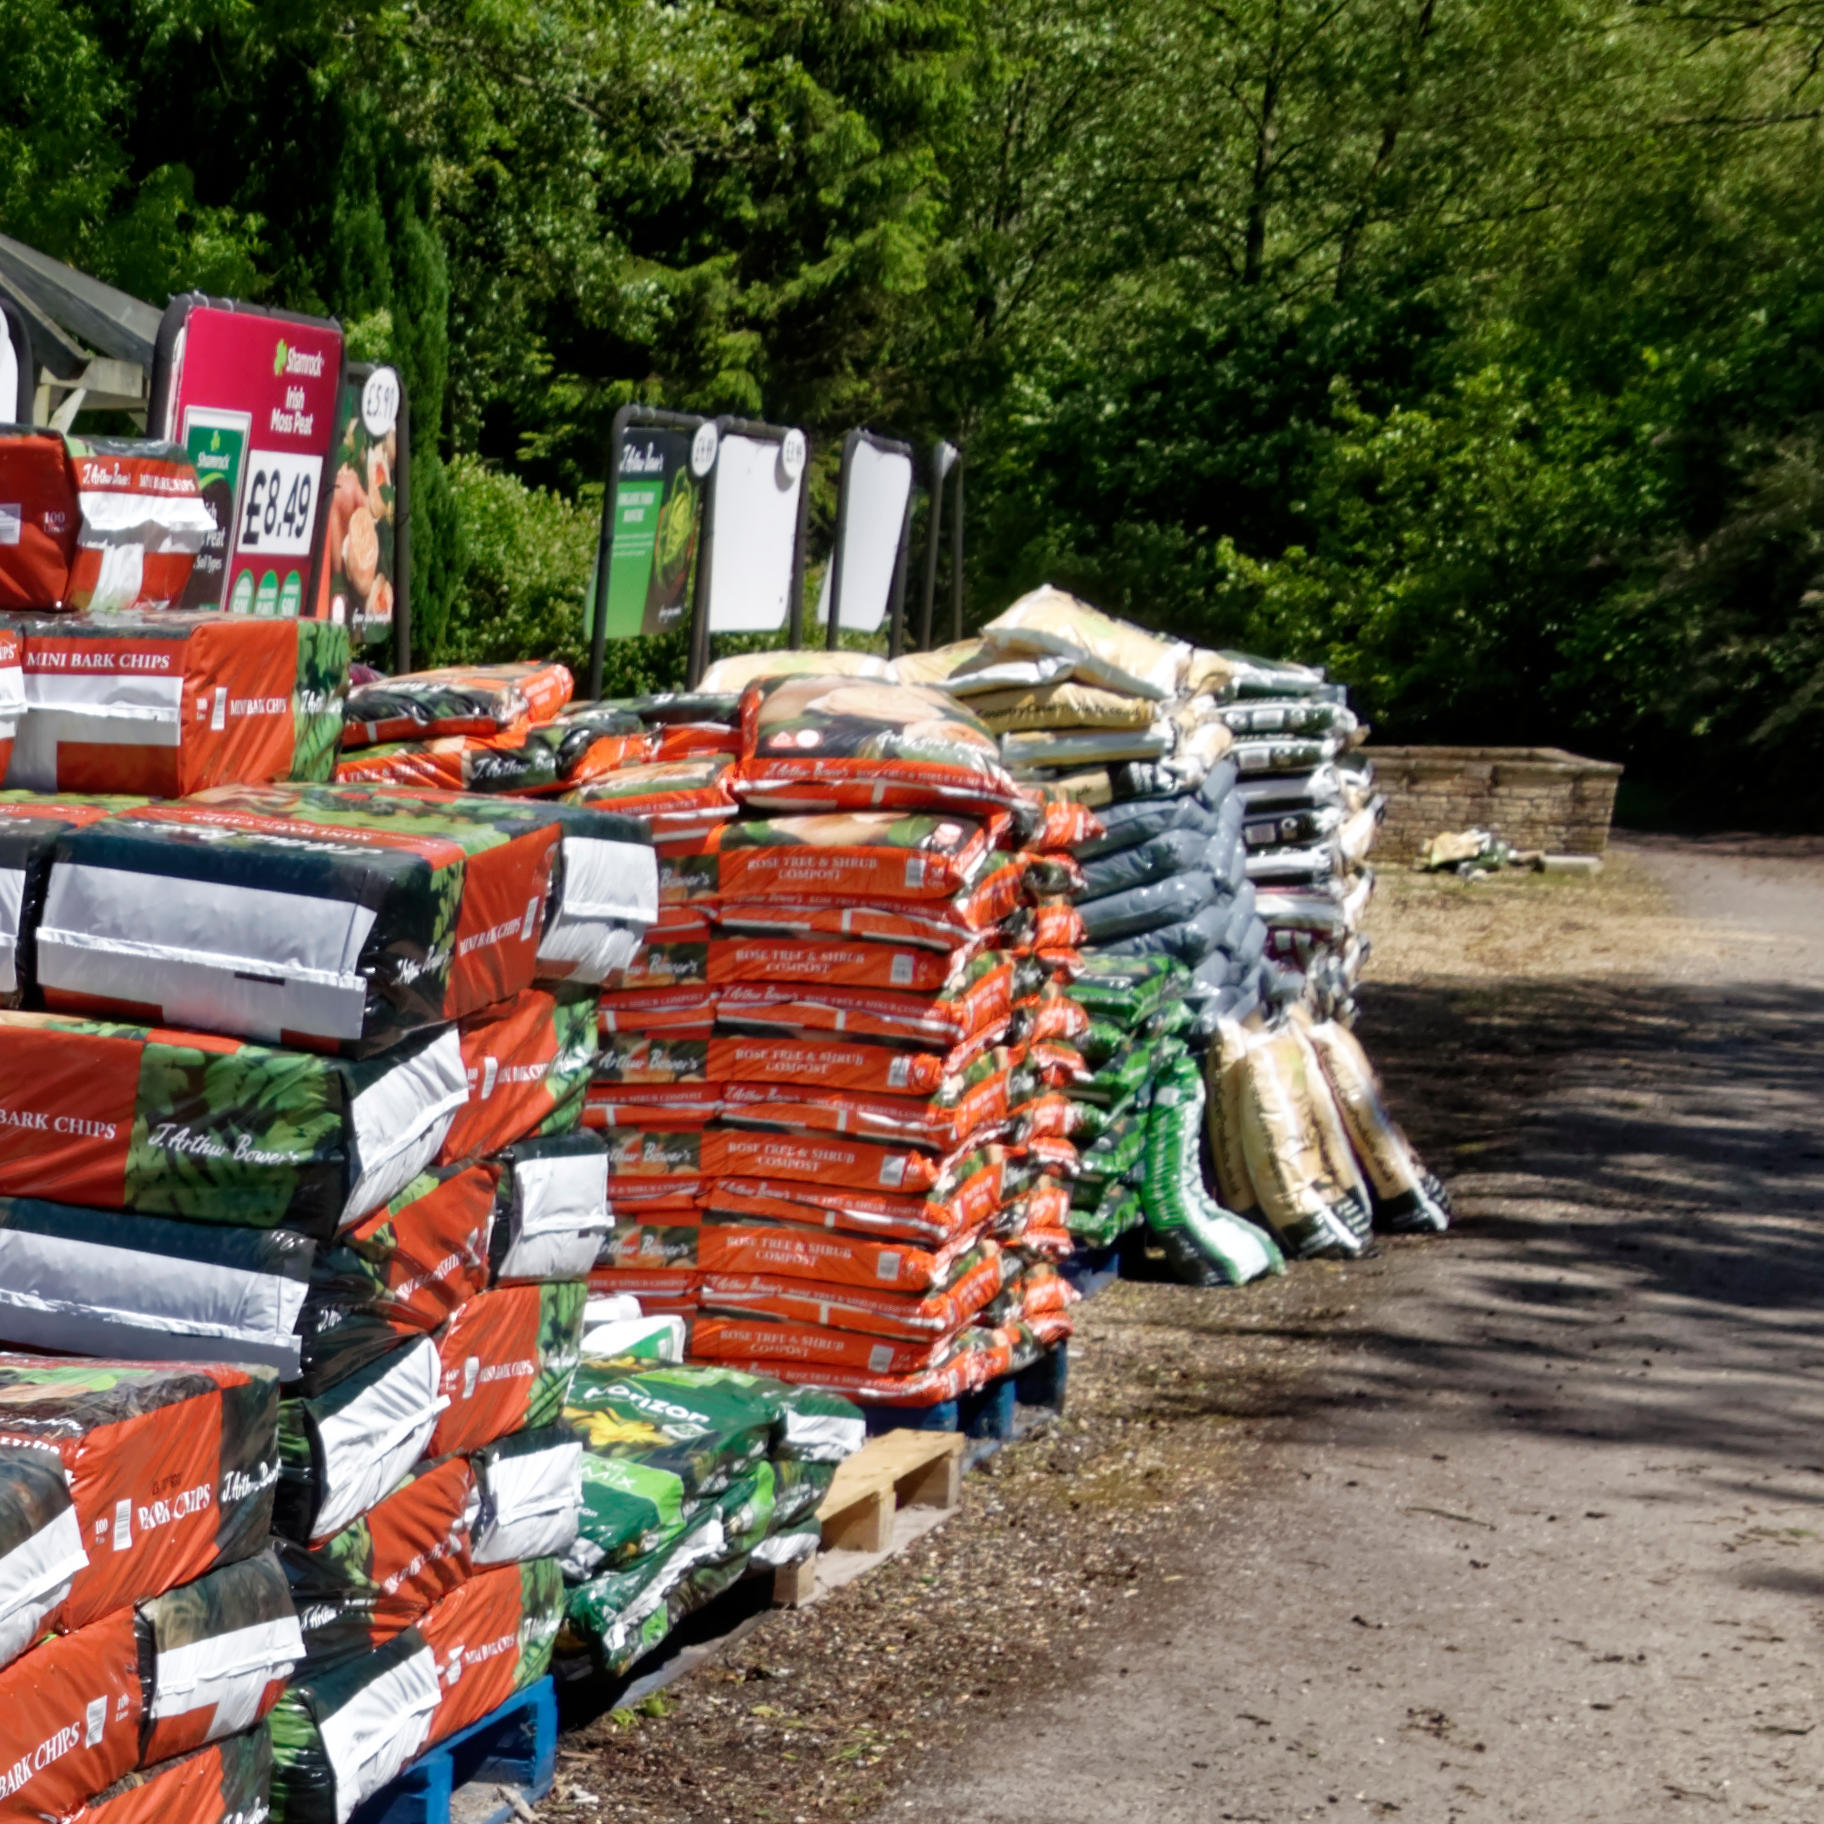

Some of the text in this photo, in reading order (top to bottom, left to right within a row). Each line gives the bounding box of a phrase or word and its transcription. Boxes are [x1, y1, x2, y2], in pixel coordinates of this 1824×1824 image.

[286, 347, 324, 377] Shamrock
[286, 386, 304, 408] Irish
[271, 410, 313, 434] Moss Peat
[198, 452, 230, 471] Shamrock
[242, 470, 311, 545] £8.49
[27, 652, 170, 669] MINI BARK CHIPS
[54, 1116, 117, 1140] CHIPS
[232, 1133, 299, 1166] Bower's
[35, 1721, 80, 1768] CHIPS
